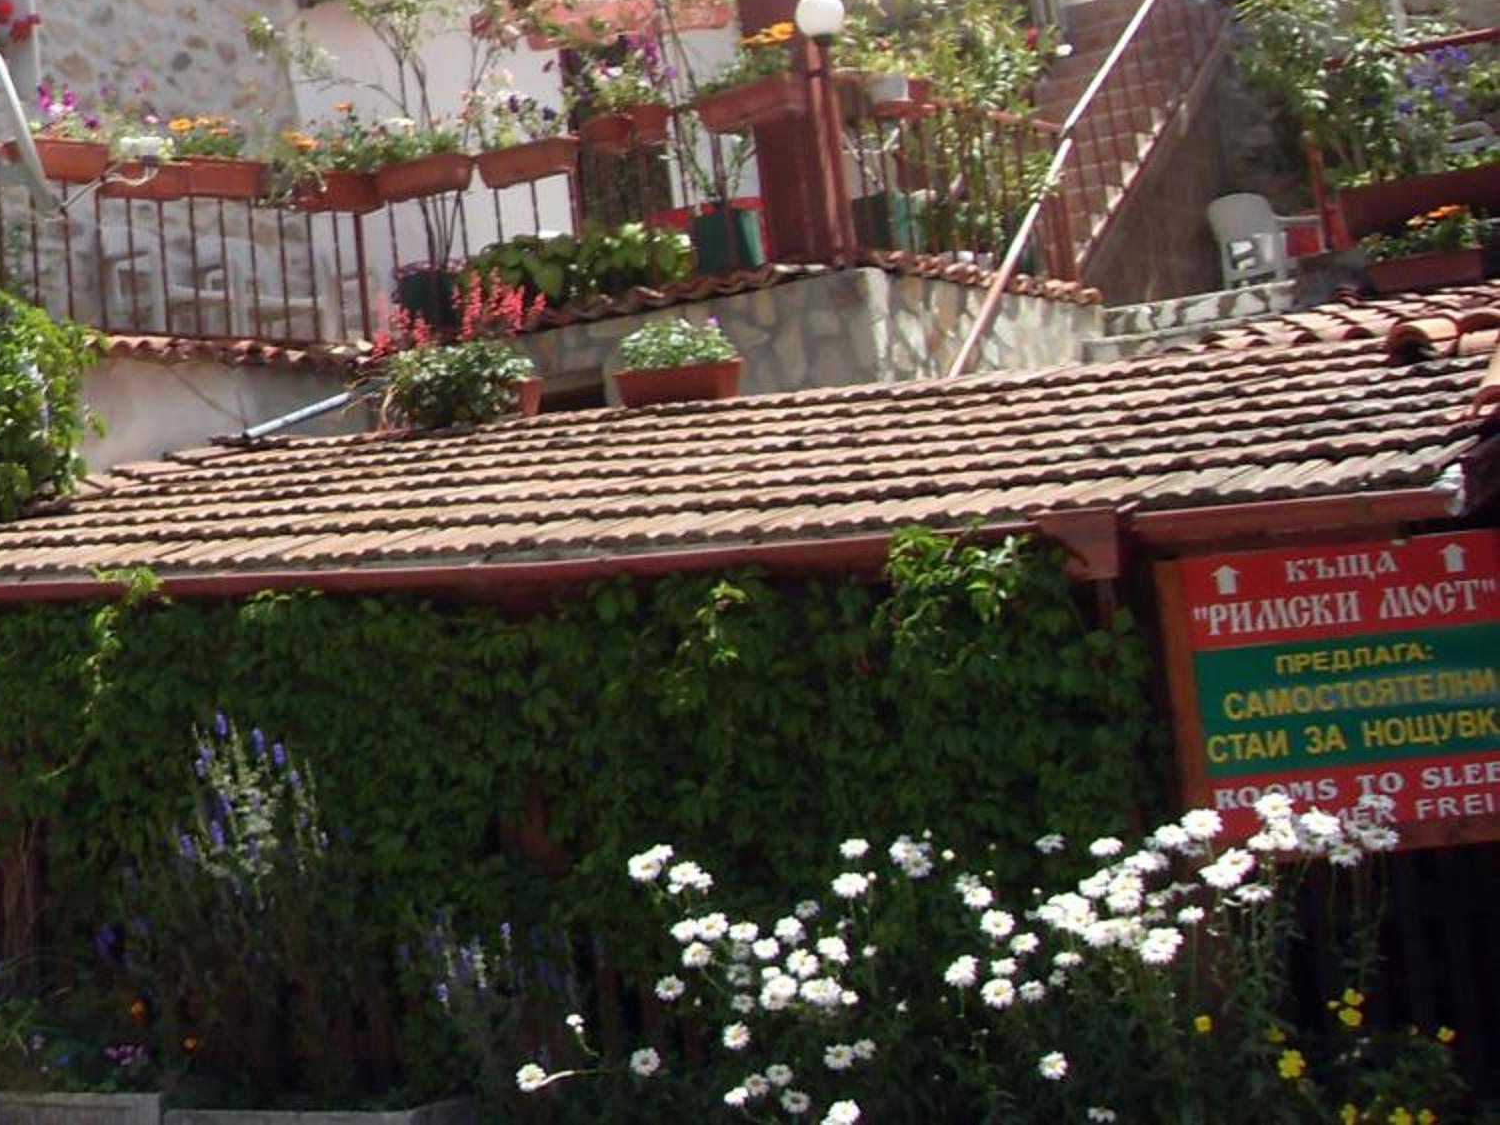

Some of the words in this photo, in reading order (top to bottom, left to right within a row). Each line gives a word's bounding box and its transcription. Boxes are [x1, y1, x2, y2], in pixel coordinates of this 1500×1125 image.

[1284, 550, 1397, 583] КЪЩА
[1275, 642, 1434, 676] ПРЕДЛАГА:
[1223, 667, 1498, 721] САМОСТОЯТЕЛНИ
[1206, 729, 1290, 764] СТАИ
[1305, 725, 1347, 754] ЗА
[1357, 771, 1404, 801] TO
[1416, 792, 1495, 821] FREI
